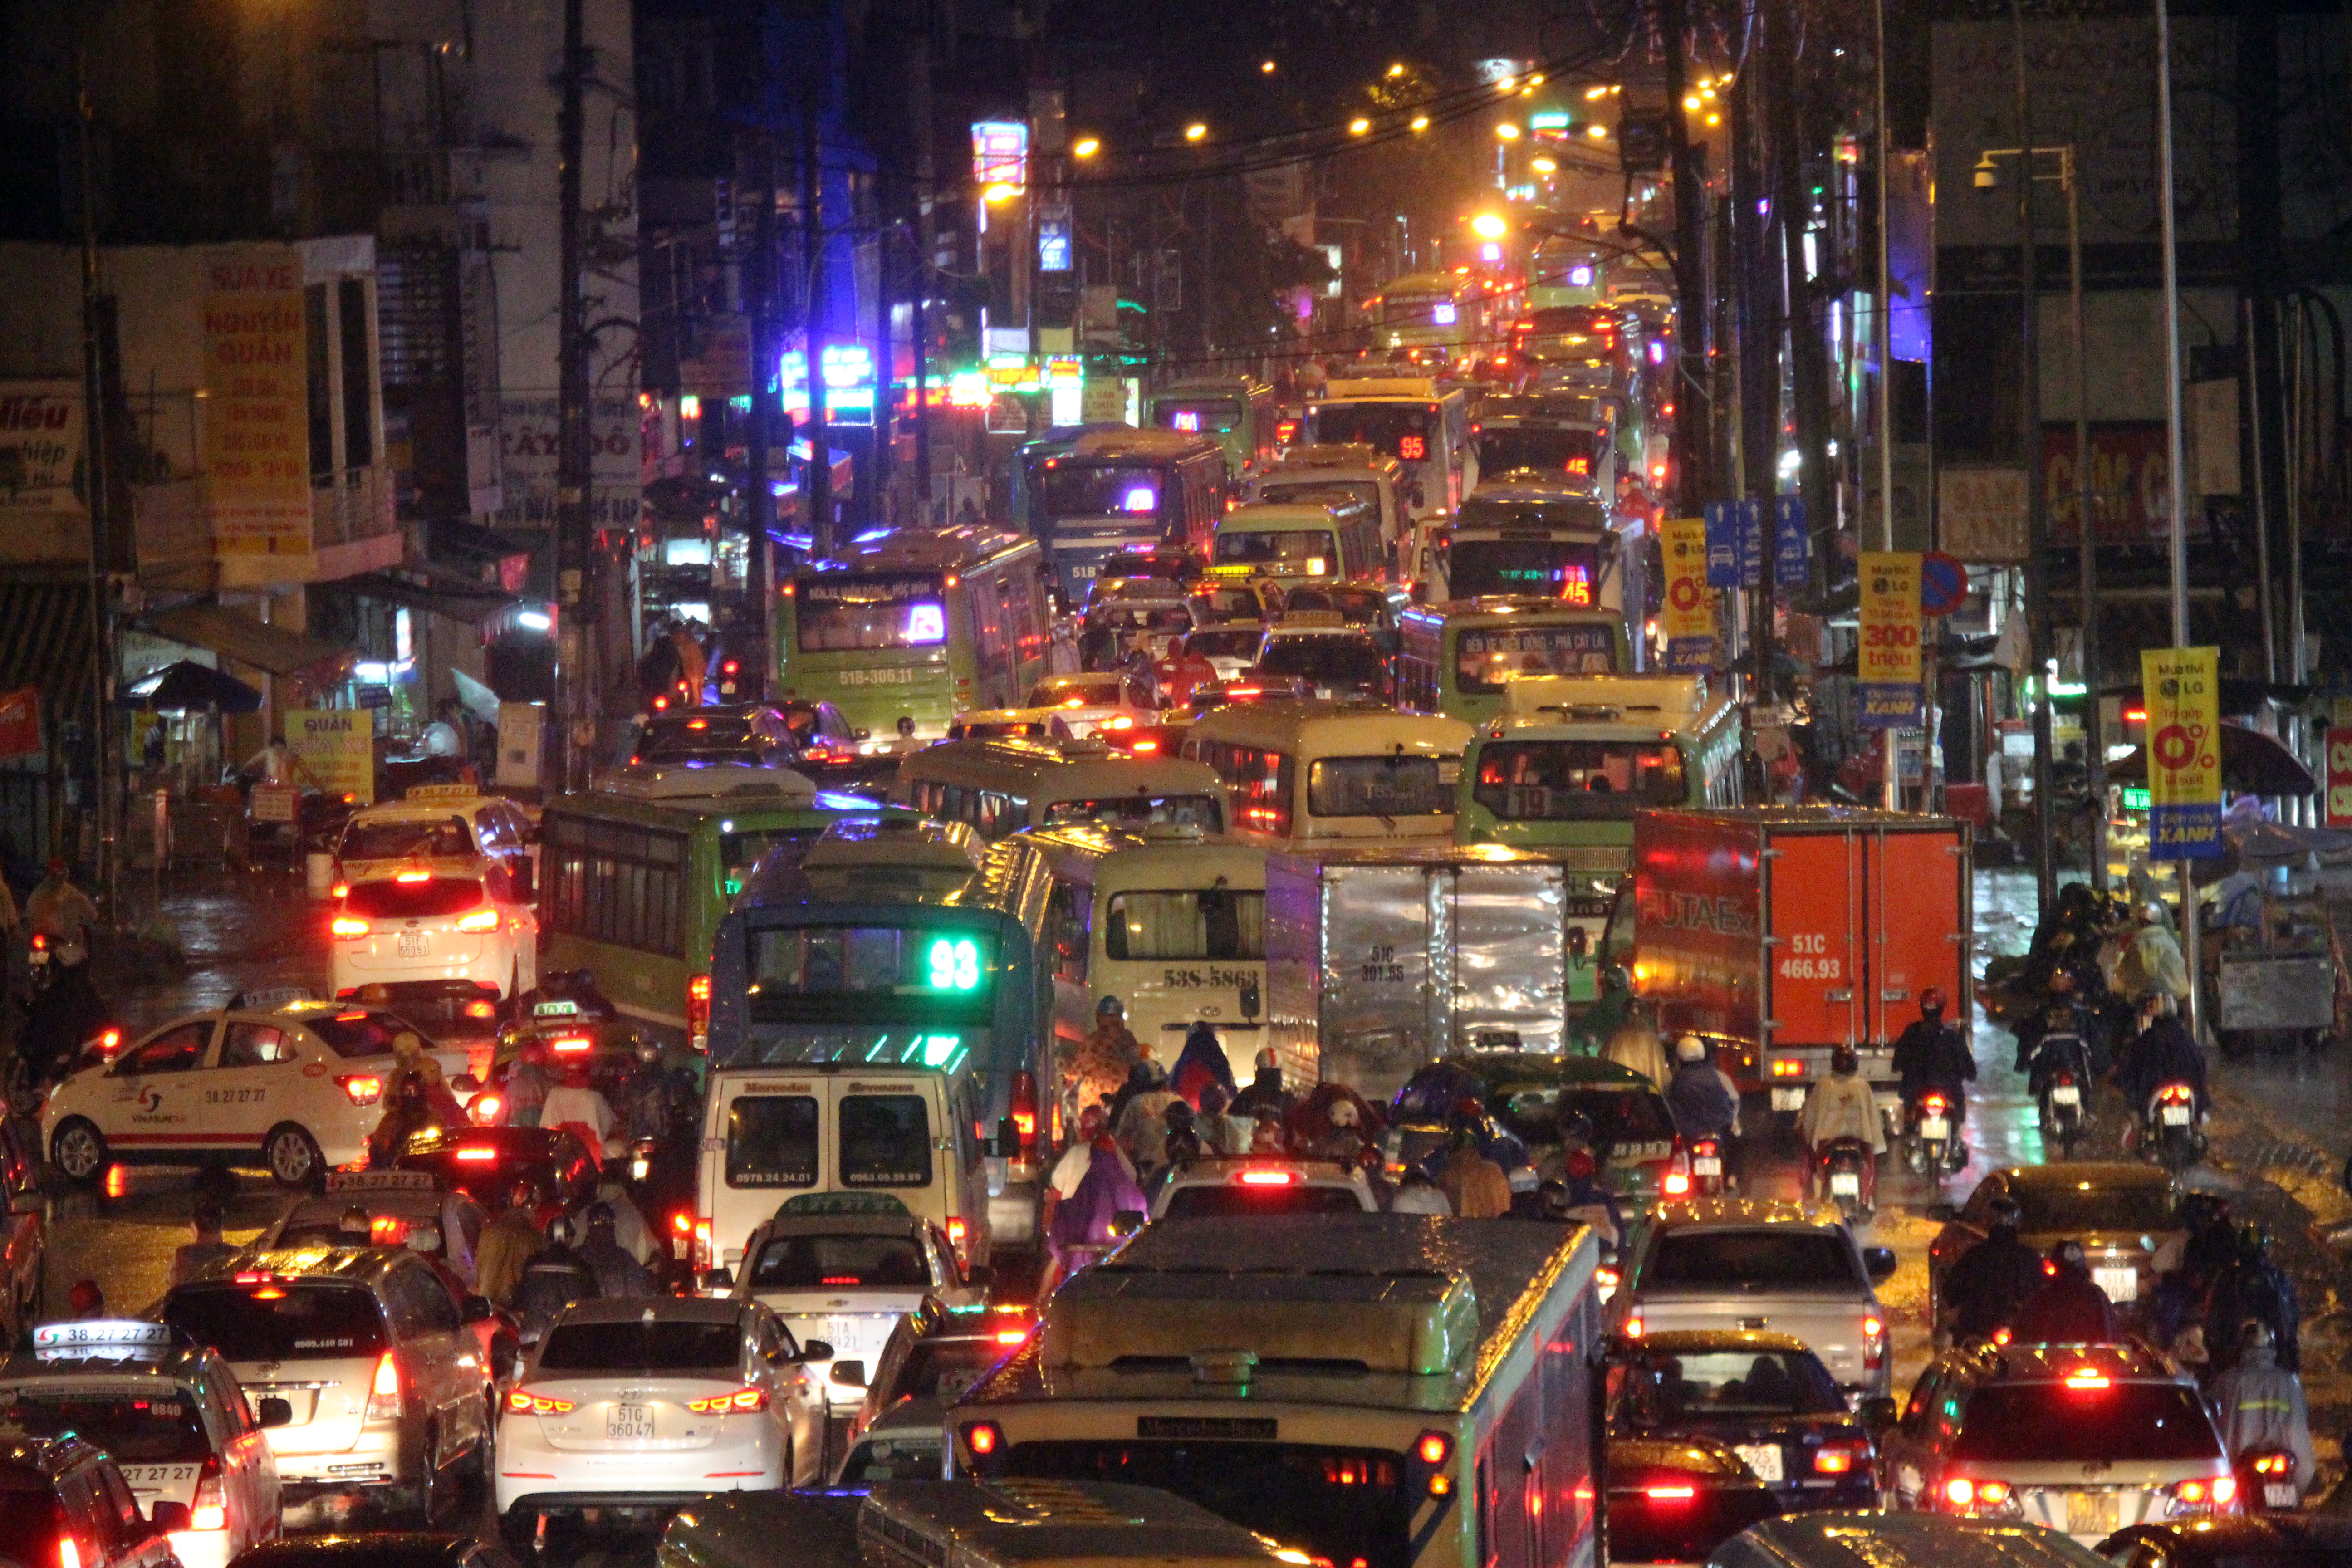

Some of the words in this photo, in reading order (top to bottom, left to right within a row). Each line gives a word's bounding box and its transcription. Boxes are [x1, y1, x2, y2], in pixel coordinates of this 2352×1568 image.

[1865, 625, 1917, 647] 300
[2184, 681, 2203, 694] LG
[1793, 934, 1826, 954] 51C
[1780, 958, 1841, 979] 466.93
[68, 1328, 113, 1342] 38.27
[121, 1328, 141, 1341] 27
[146, 1327, 166, 1341] 27
[618, 1408, 643, 1422] 51G
[149, 1468, 168, 1480] 27
[174, 1467, 194, 1480] 27
